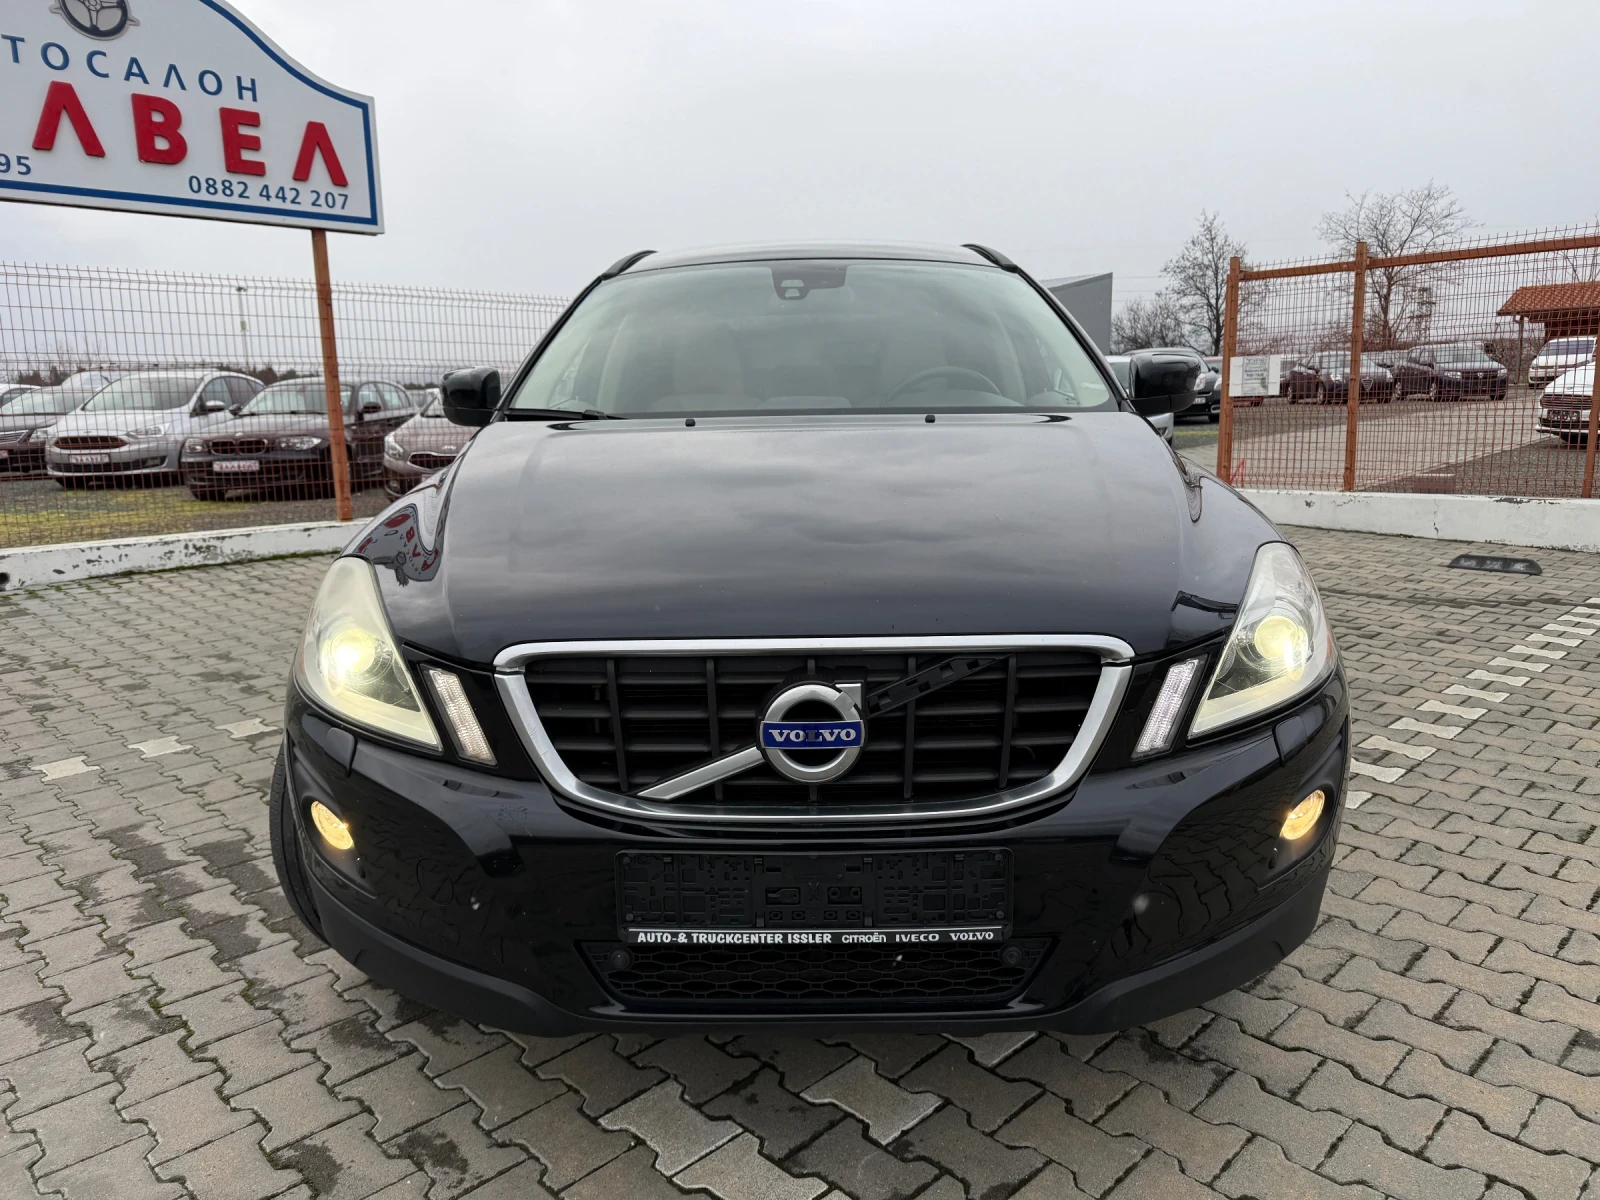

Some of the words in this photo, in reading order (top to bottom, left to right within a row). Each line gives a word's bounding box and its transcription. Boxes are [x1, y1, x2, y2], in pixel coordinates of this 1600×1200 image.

[188, 175, 251, 199] 0882
[258, 183, 302, 206] 442
[310, 190, 349, 210] 207
[768, 728, 857, 742] VOLVO
[691, 932, 784, 944] TRUCKCENTER
[787, 932, 832, 944] ISSLER
[895, 933, 940, 943] IVECO
[949, 931, 994, 941] VOLVO
